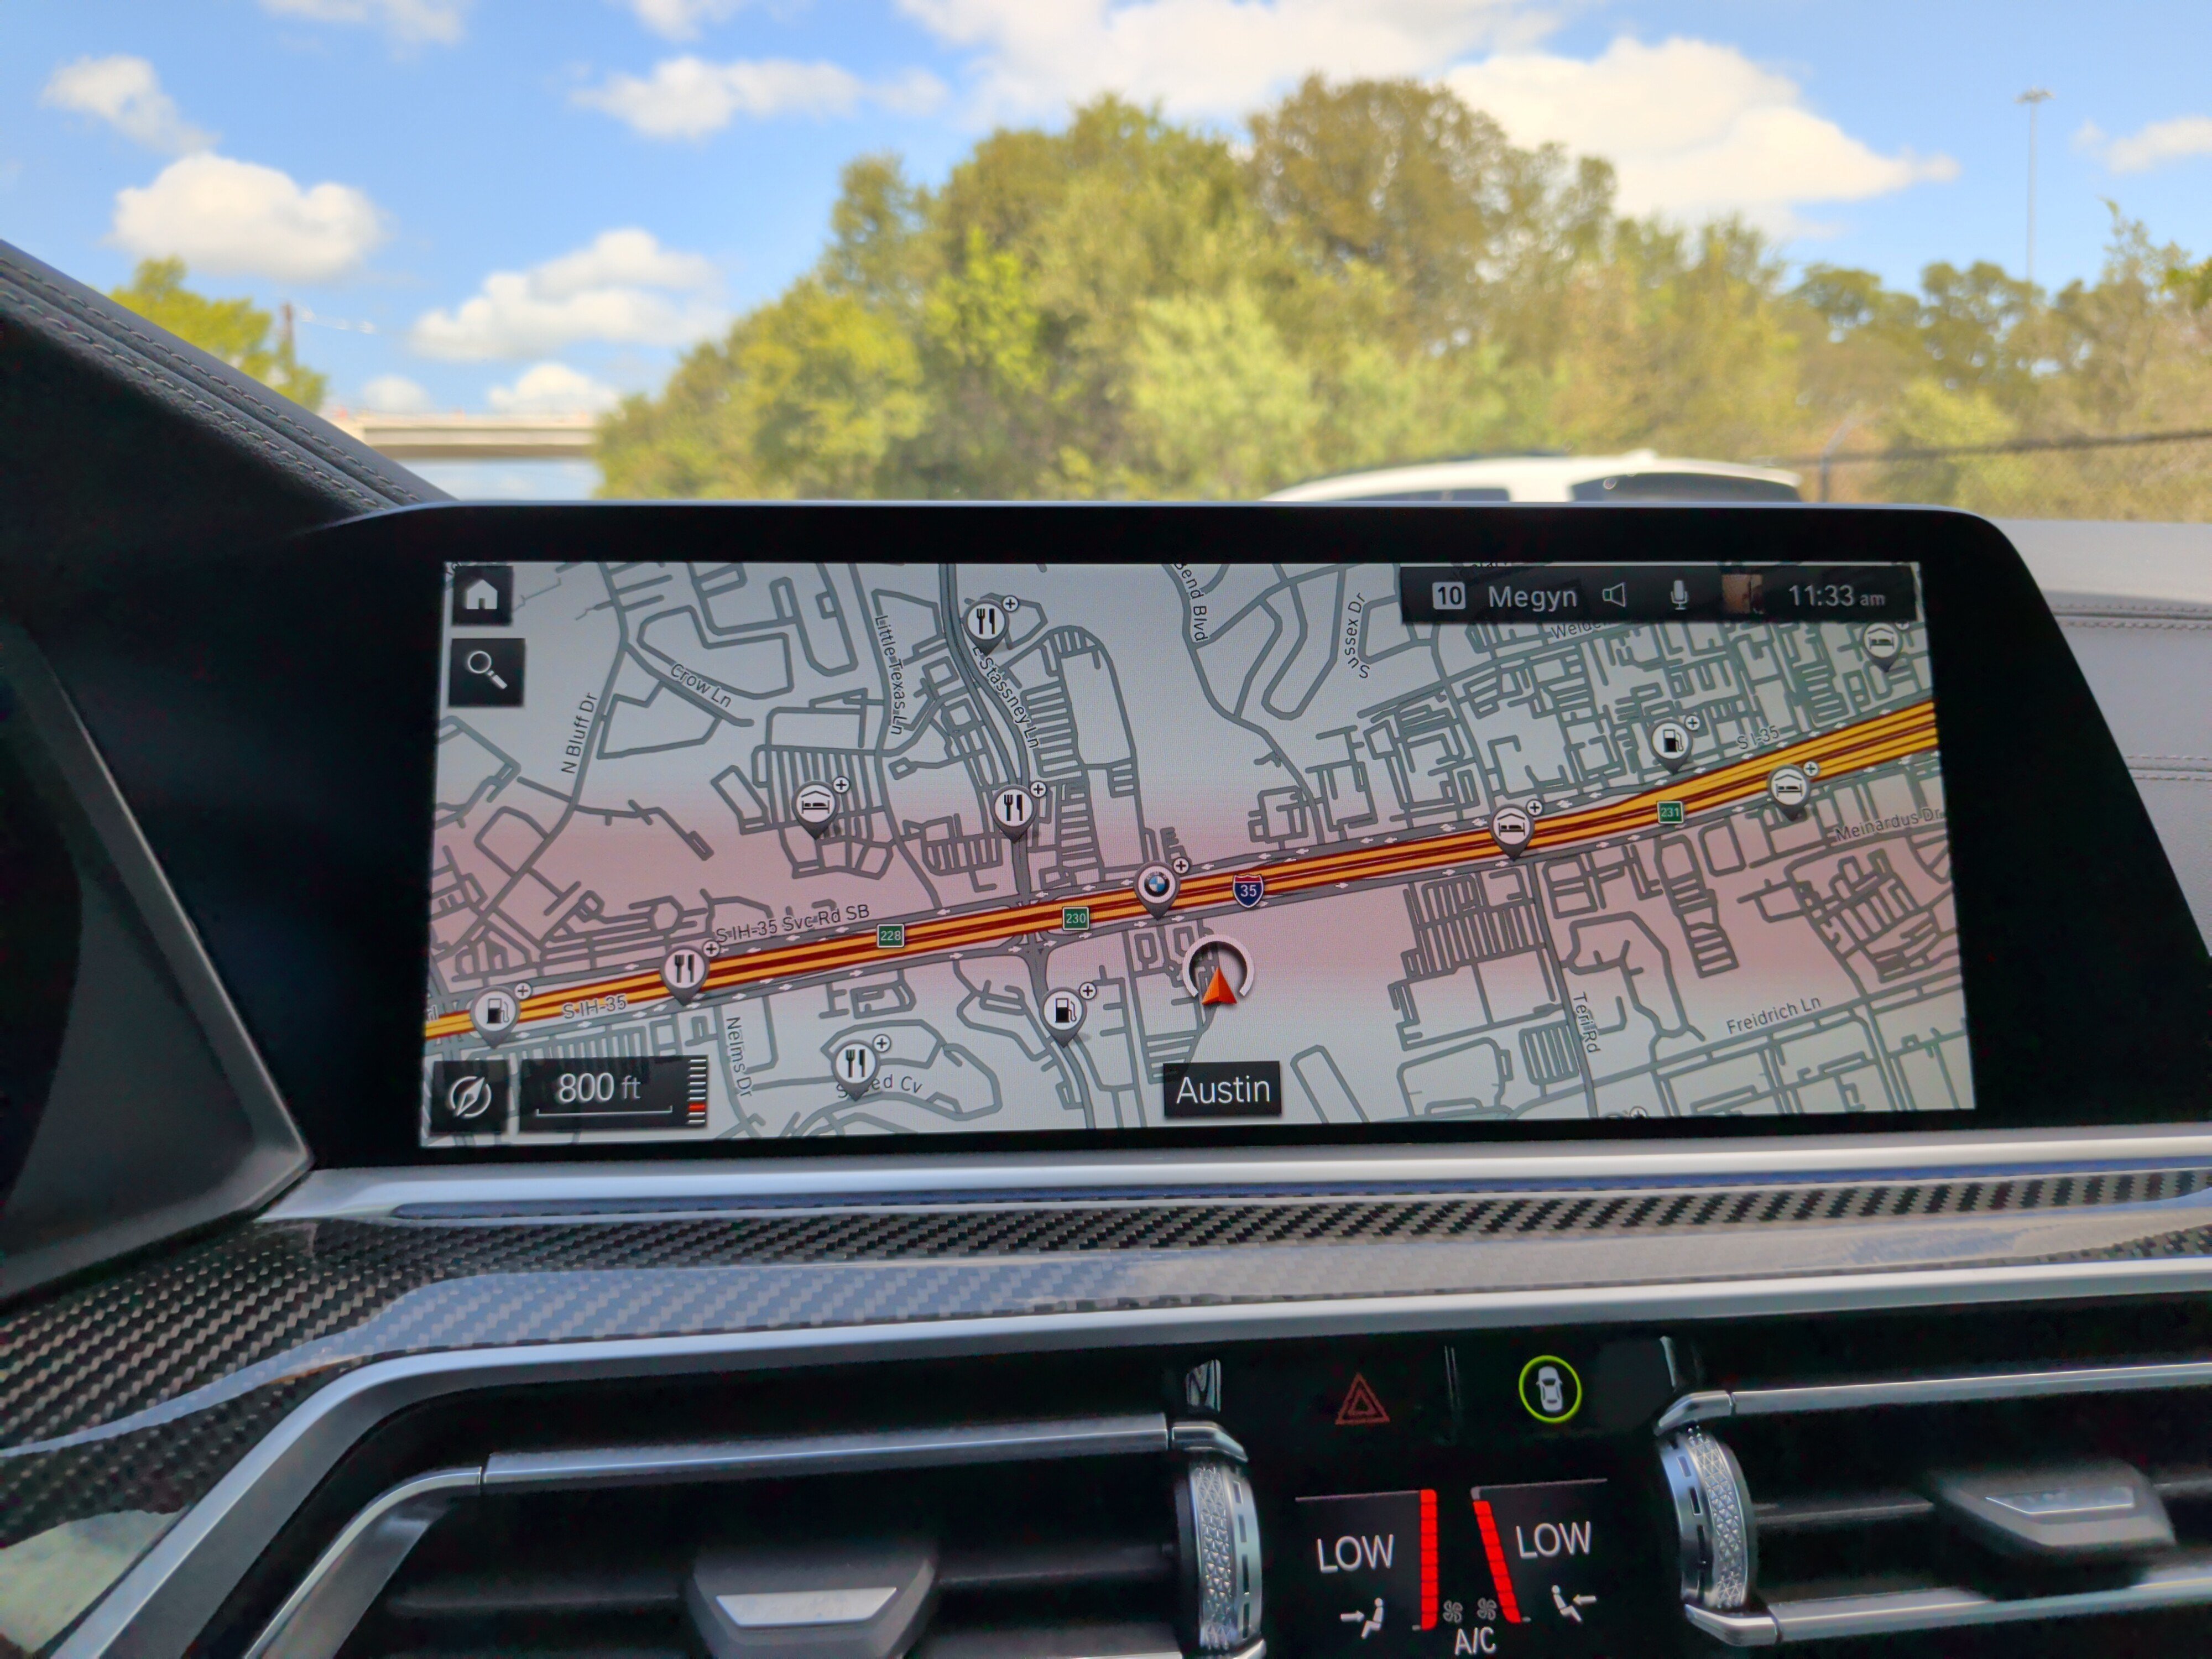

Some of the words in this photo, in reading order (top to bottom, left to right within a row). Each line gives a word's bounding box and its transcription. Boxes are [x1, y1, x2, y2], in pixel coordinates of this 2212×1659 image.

[1348, 592, 1366, 614] Dr
[1438, 586, 1462, 606] 10
[1489, 586, 1578, 612] Megyn
[1788, 585, 1854, 607] 11:33
[1860, 593, 1886, 606] am
[875, 614, 896, 657] Little
[1193, 605, 1209, 641] Blvd
[1344, 618, 1371, 679] Sussex
[671, 664, 710, 695] Crow
[711, 686, 732, 708] Ln
[889, 659, 907, 710] Texas
[580, 692, 598, 712] Dr
[979, 657, 1030, 724] Stassney
[1024, 727, 1039, 749] Ln
[566, 714, 594, 758] Bluff
[890, 714, 907, 735] Ln
[1737, 735, 1749, 749] S
[1751, 725, 1779, 745] I-35
[561, 761, 577, 775] N
[1661, 806, 1681, 818] 231
[1835, 812, 1919, 842] Meinardus
[1240, 885, 1257, 898] 35
[717, 927, 728, 942] S
[733, 919, 778, 941] IH-35
[782, 916, 814, 932] Svc
[818, 910, 841, 925] Rd
[846, 904, 870, 920] SB
[1065, 912, 1086, 925] 230
[880, 930, 902, 942] 228
[564, 1004, 576, 1019] S
[580, 995, 628, 1017] IH-35
[1573, 992, 1594, 1026] Teri
[1726, 1001, 1798, 1035] Freidrich
[1799, 996, 1822, 1014] Ln
[725, 1015, 747, 1074] Nelms
[737, 1076, 754, 1097] Dr
[1583, 1031, 1601, 1053] Rd
[558, 1071, 615, 1103] 800
[622, 1075, 641, 1100] ft
[836, 1074, 893, 1098] Sed
[901, 1076, 923, 1094] Cv
[1176, 1076, 1270, 1105] Austin
[1317, 1533, 1394, 1574] LOW
[1516, 1521, 1592, 1559] LOW
[1454, 1626, 1496, 1656] A/C
